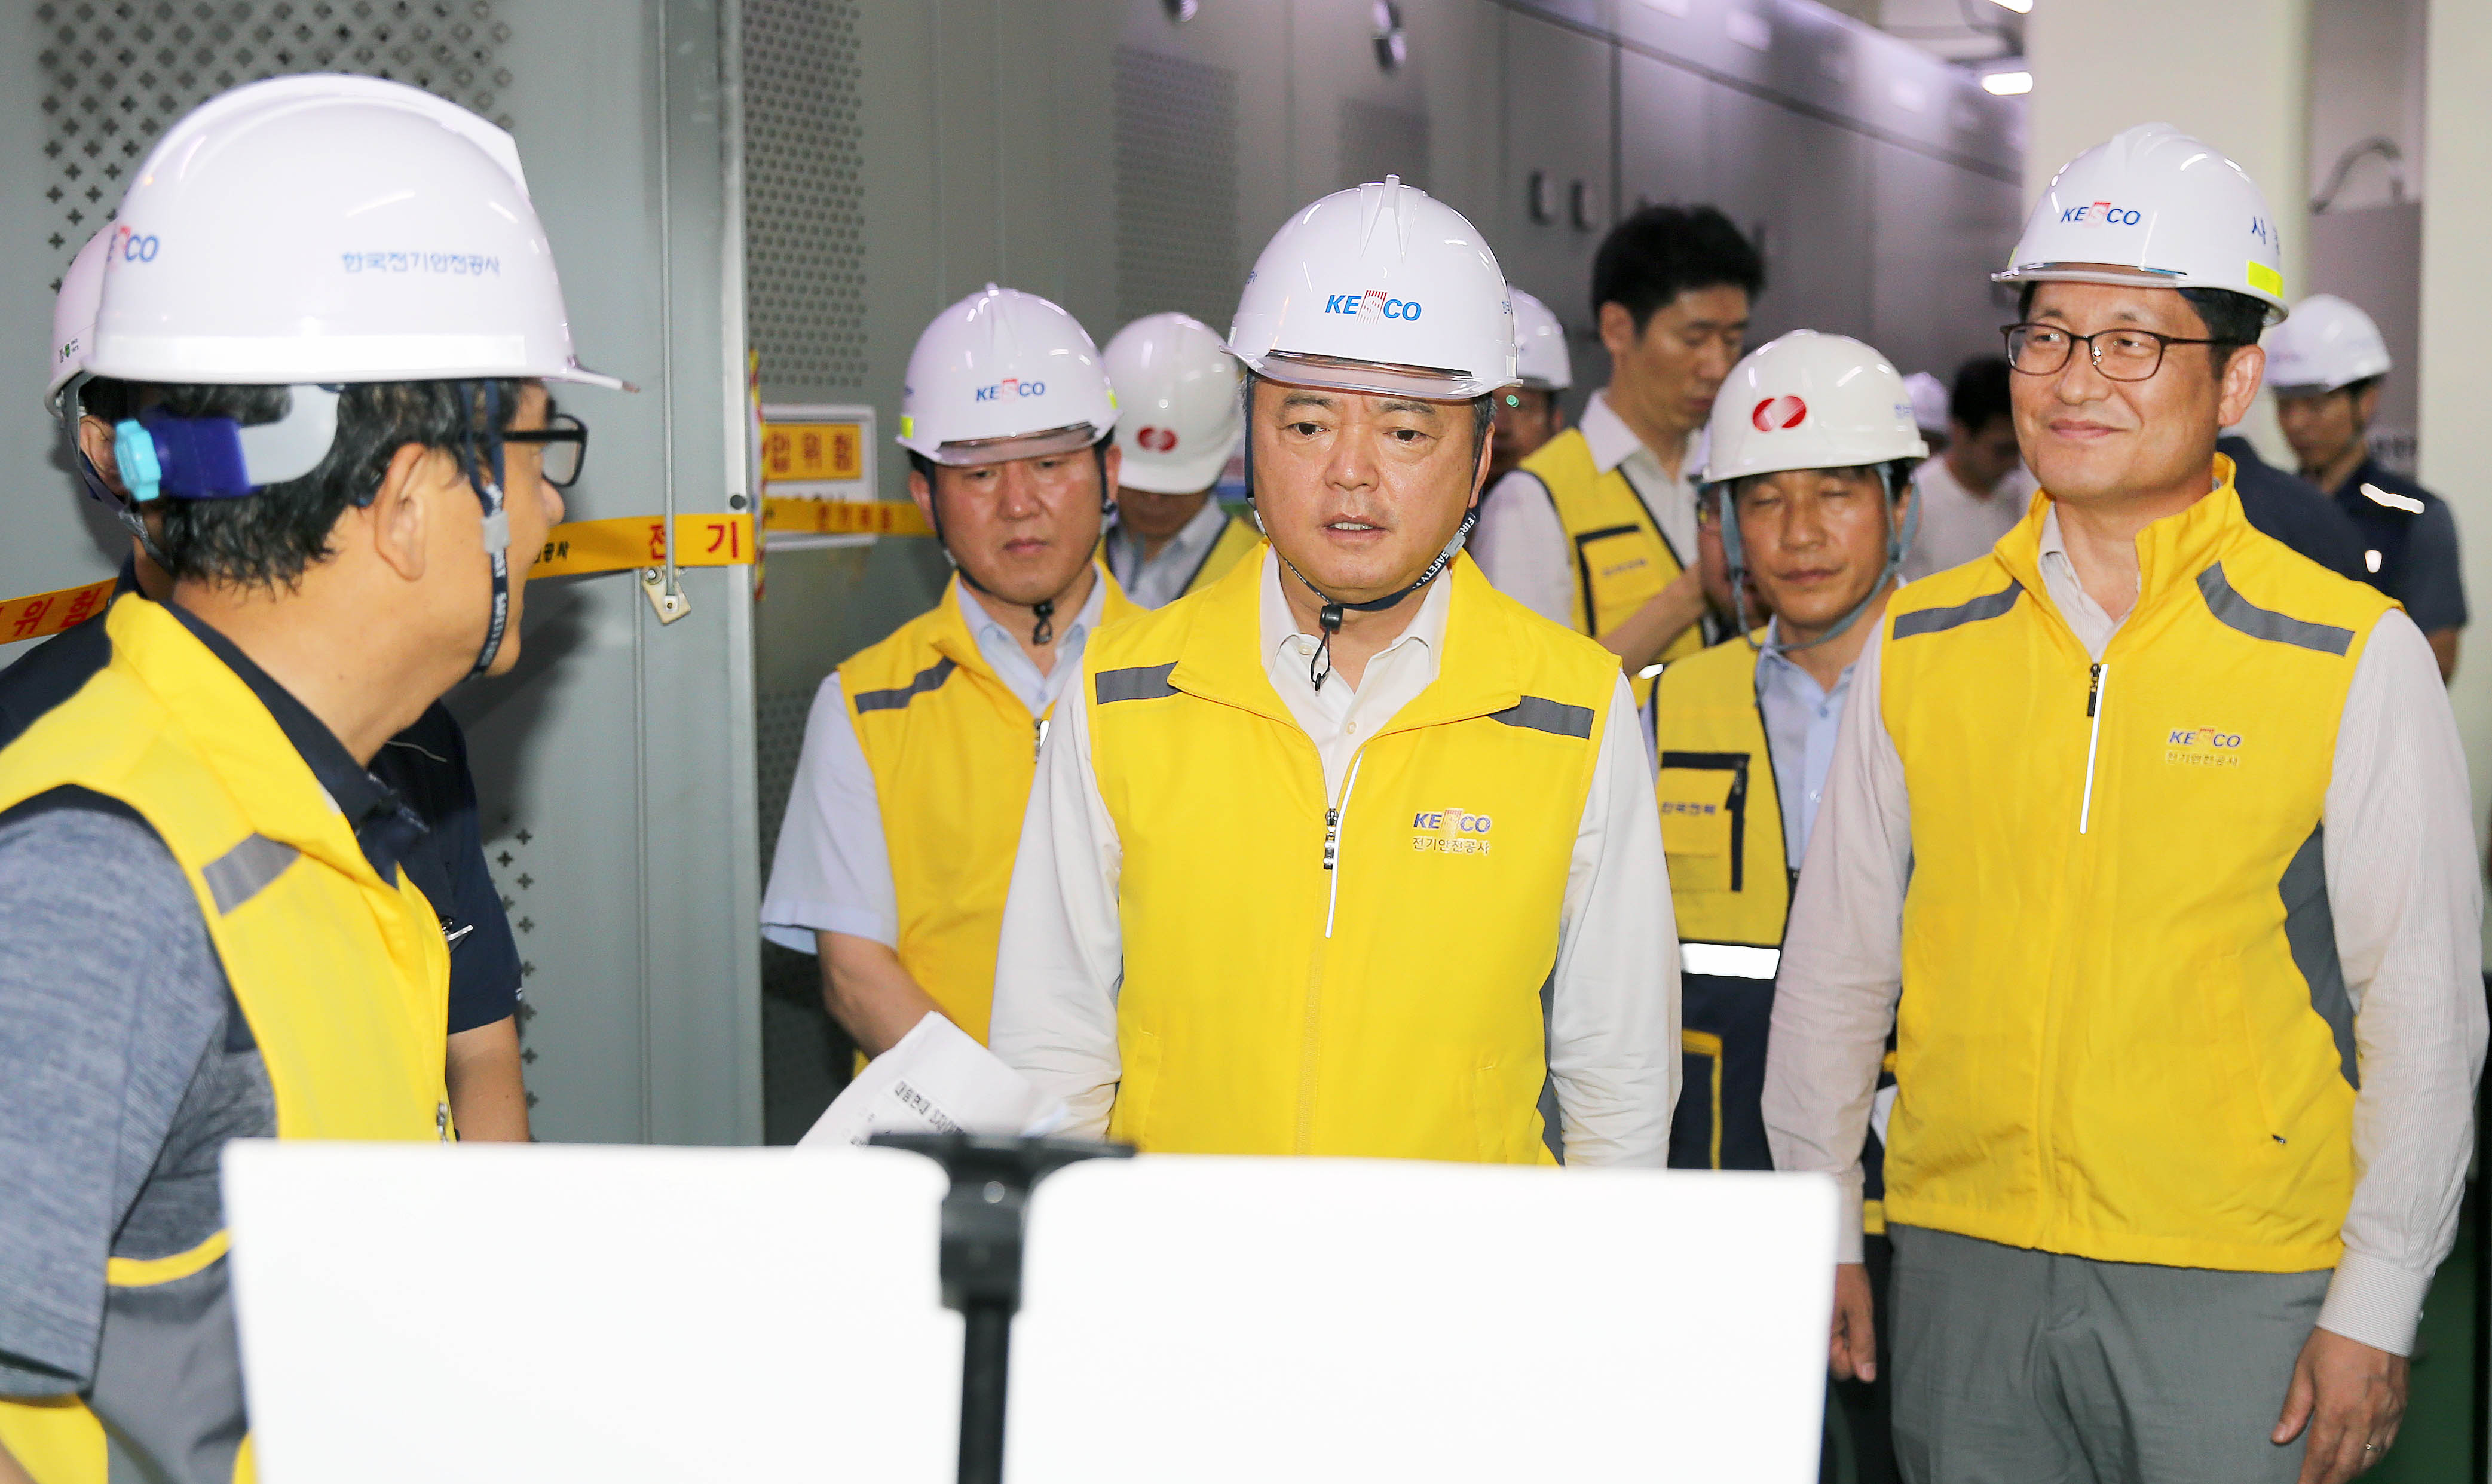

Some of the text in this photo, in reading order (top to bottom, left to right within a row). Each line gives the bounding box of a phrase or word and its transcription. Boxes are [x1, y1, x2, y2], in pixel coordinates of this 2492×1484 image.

[2061, 201, 2141, 228] KESCO
[1324, 289, 1422, 324] KESCO
[976, 378, 1045, 403] KESCO
[534, 540, 570, 564] 공사
[1420, 550, 1449, 582] SAFETY
[0, 586, 104, 637] 위험
[2169, 728, 2241, 747] KESCO
[1413, 809, 1492, 836] KESCO
[1412, 837, 1490, 854] 전기안전공사
